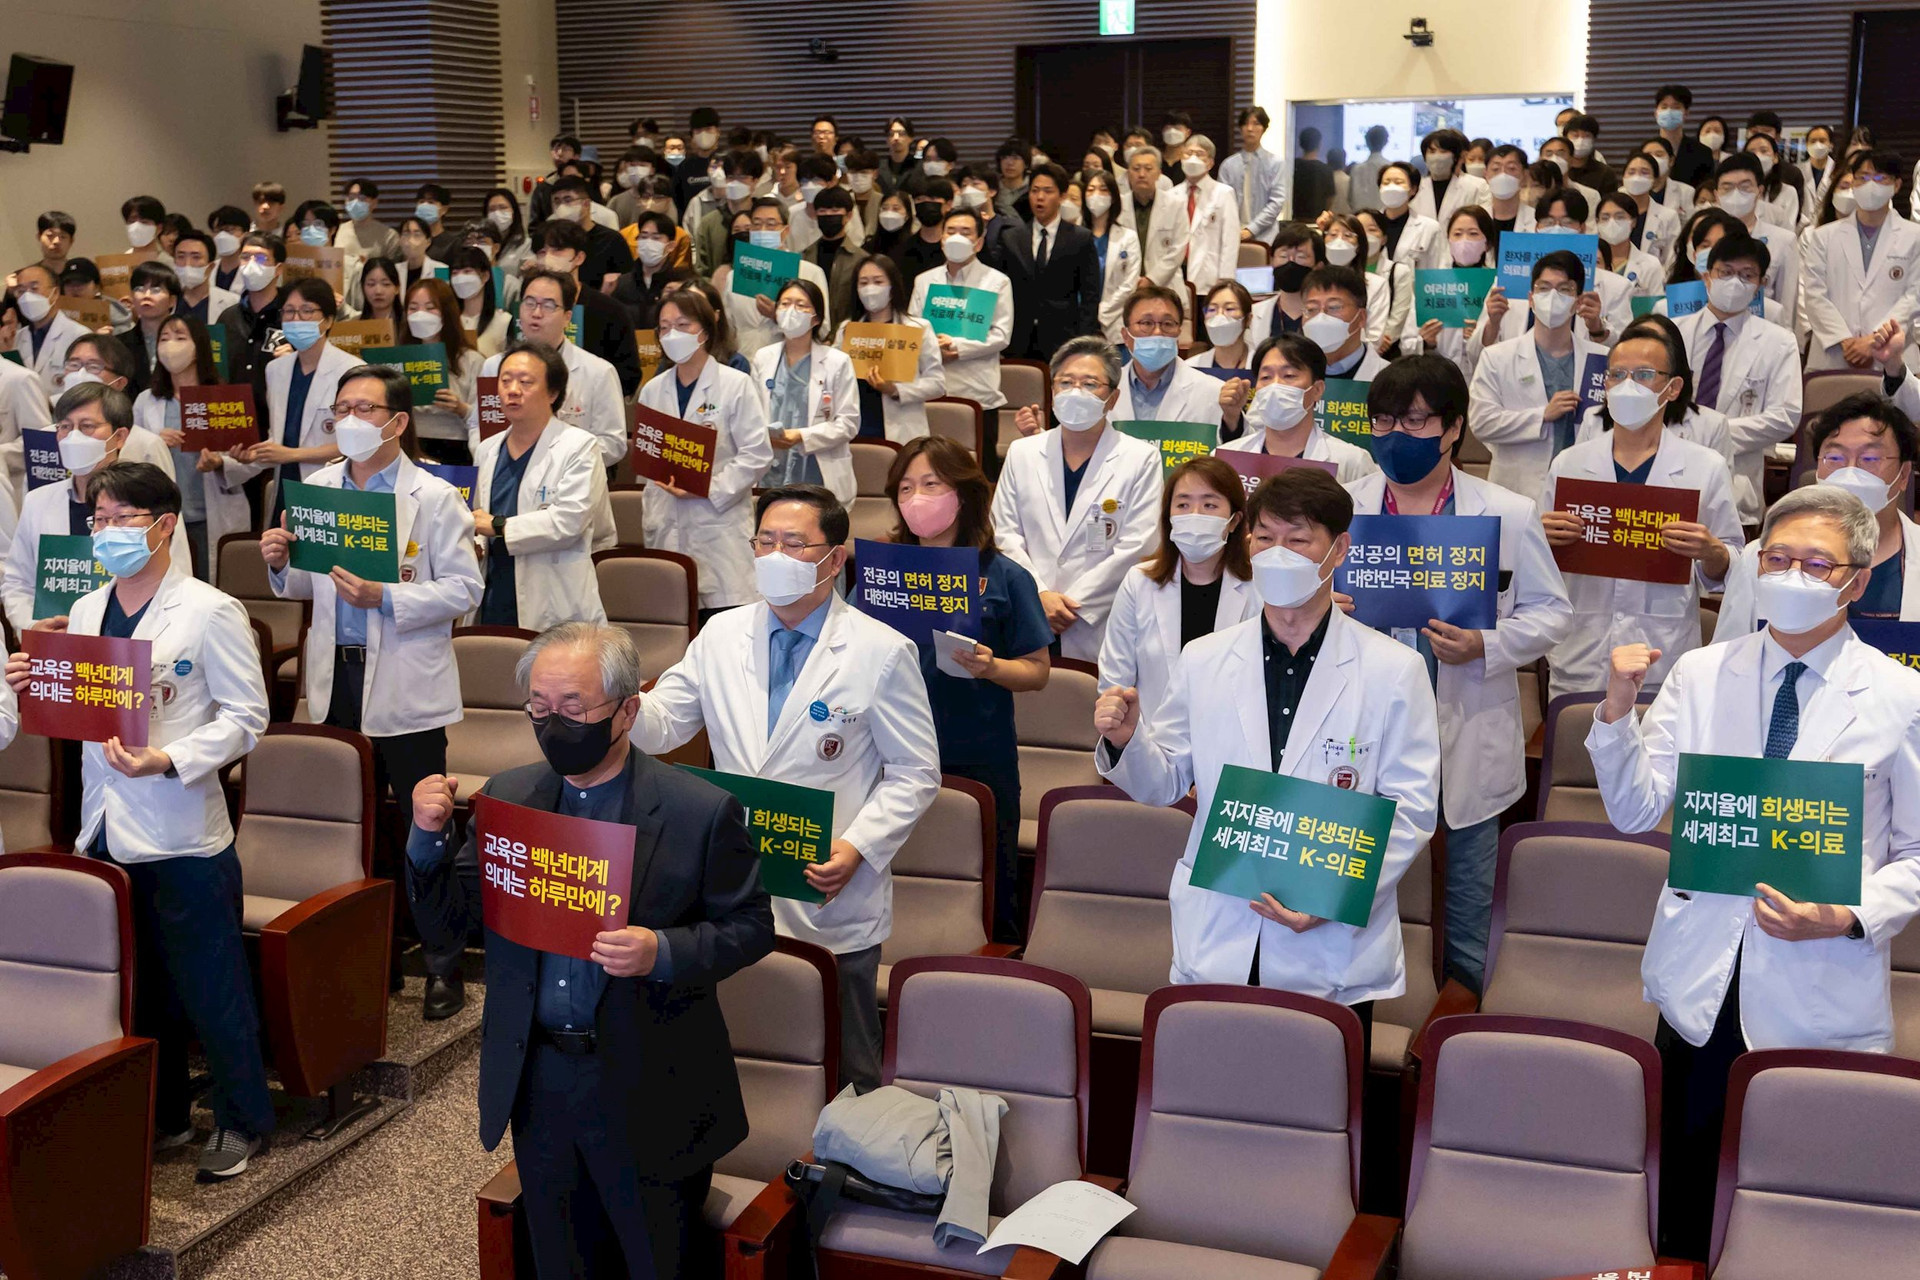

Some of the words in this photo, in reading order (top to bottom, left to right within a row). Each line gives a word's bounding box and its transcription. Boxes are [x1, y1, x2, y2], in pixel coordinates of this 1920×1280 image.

[1424, 283, 1468, 295] 여러분이
[932, 297, 968, 310] 여러분이
[1425, 298, 1456, 309] 치료해
[1463, 297, 1485, 308] 주세
[931, 309, 957, 320] 치료해
[958, 310, 985, 325] 주세요
[850, 337, 886, 350] 여러분이
[909, 341, 919, 352] 수
[410, 373, 444, 386] K-의료
[185, 402, 208, 416] 교육은
[207, 401, 246, 416] 백년대계
[481, 410, 506, 424] 의대는
[1326, 401, 1369, 418] 희생되
[186, 417, 209, 430] 의대는
[209, 416, 254, 430] 하루만에?
[1331, 420, 1373, 435] K-의료
[638, 423, 665, 445] 교육은
[664, 433, 705, 458] 백년대계
[1162, 440, 1210, 456] 희생되는
[29, 449, 60, 466] 전공의
[635, 437, 662, 459] 의대는
[661, 448, 711, 474] 하루만에?
[31, 466, 67, 481] 대한민국
[291, 506, 336, 528] 지지율에
[337, 513, 391, 534] 희생되는
[293, 525, 339, 547] 세계최고
[344, 533, 390, 552] K-의료
[1580, 525, 1611, 545] 대는
[1347, 544, 1402, 565] 전공의
[1407, 545, 1443, 566] 면허
[1449, 546, 1486, 567] 정지
[44, 557, 92, 576] 지지율에
[44, 576, 92, 594] 세계최고
[863, 566, 901, 588] 전공의
[904, 572, 934, 592] 면허
[936, 573, 969, 593] 정지
[1450, 571, 1486, 591] 정지
[940, 596, 970, 614] 정지
[29, 659, 74, 681] 교육은
[75, 662, 134, 687] 백년대계
[29, 681, 74, 704] 의대는
[75, 685, 145, 711] 하루만에?
[1683, 790, 1757, 820] 지지율에
[1760, 796, 1850, 826] 희생되는
[753, 809, 823, 840] 희생되는
[1219, 799, 1295, 835] 지지율에
[1295, 815, 1377, 854] 희생되는
[1681, 820, 1760, 849] 세계최고
[1771, 828, 1847, 856] K-의료
[760, 836, 819, 862] K-의료
[1211, 826, 1290, 861] 세계최고
[1298, 846, 1368, 880] K-의료
[484, 832, 529, 868] 교육은
[531, 846, 610, 887] 백년대계
[485, 862, 527, 898] 의대는
[529, 876, 623, 917] 하루만에?
